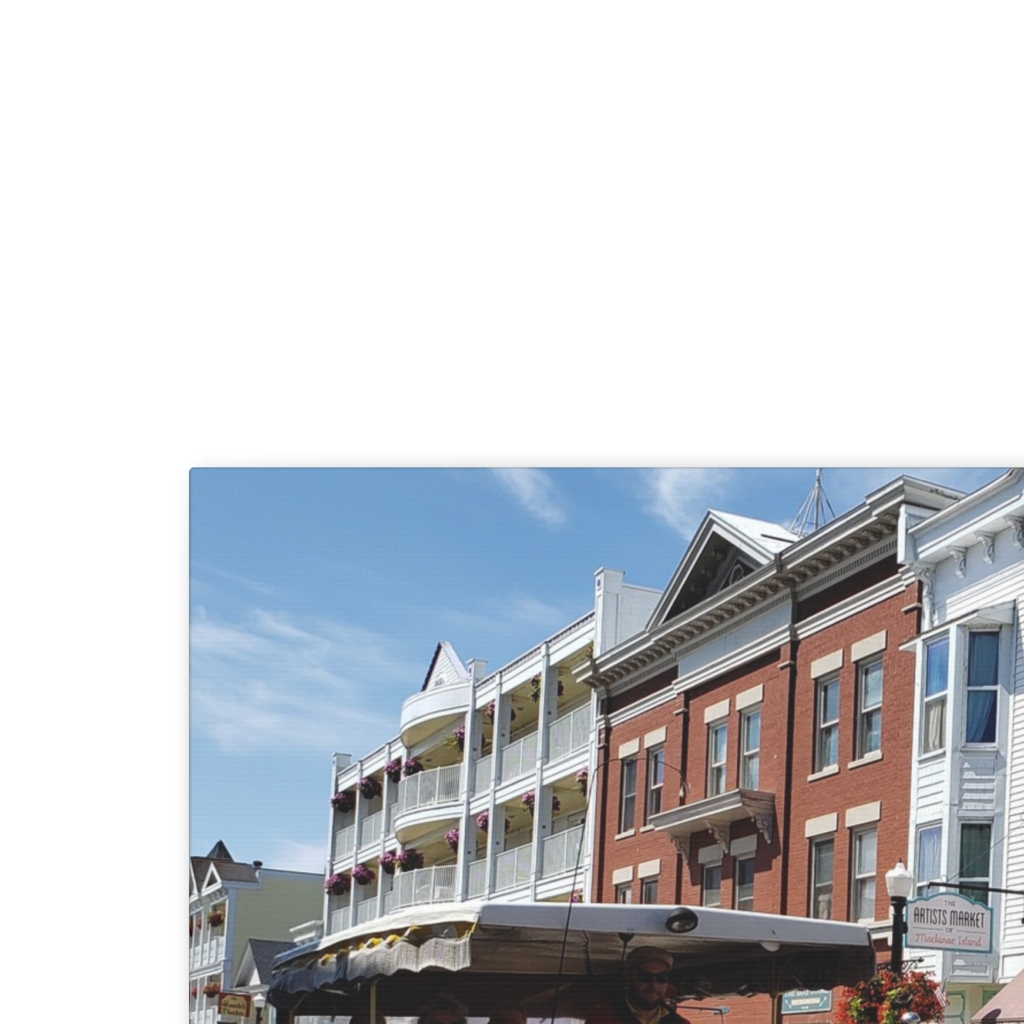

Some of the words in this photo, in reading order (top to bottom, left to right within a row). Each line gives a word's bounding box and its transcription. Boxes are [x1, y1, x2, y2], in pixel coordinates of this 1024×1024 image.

[913, 906, 948, 926] ARTISTS
[950, 910, 985, 928] MARKET
[915, 932, 955, 945] Mackinac
[958, 936, 982, 947] Island
